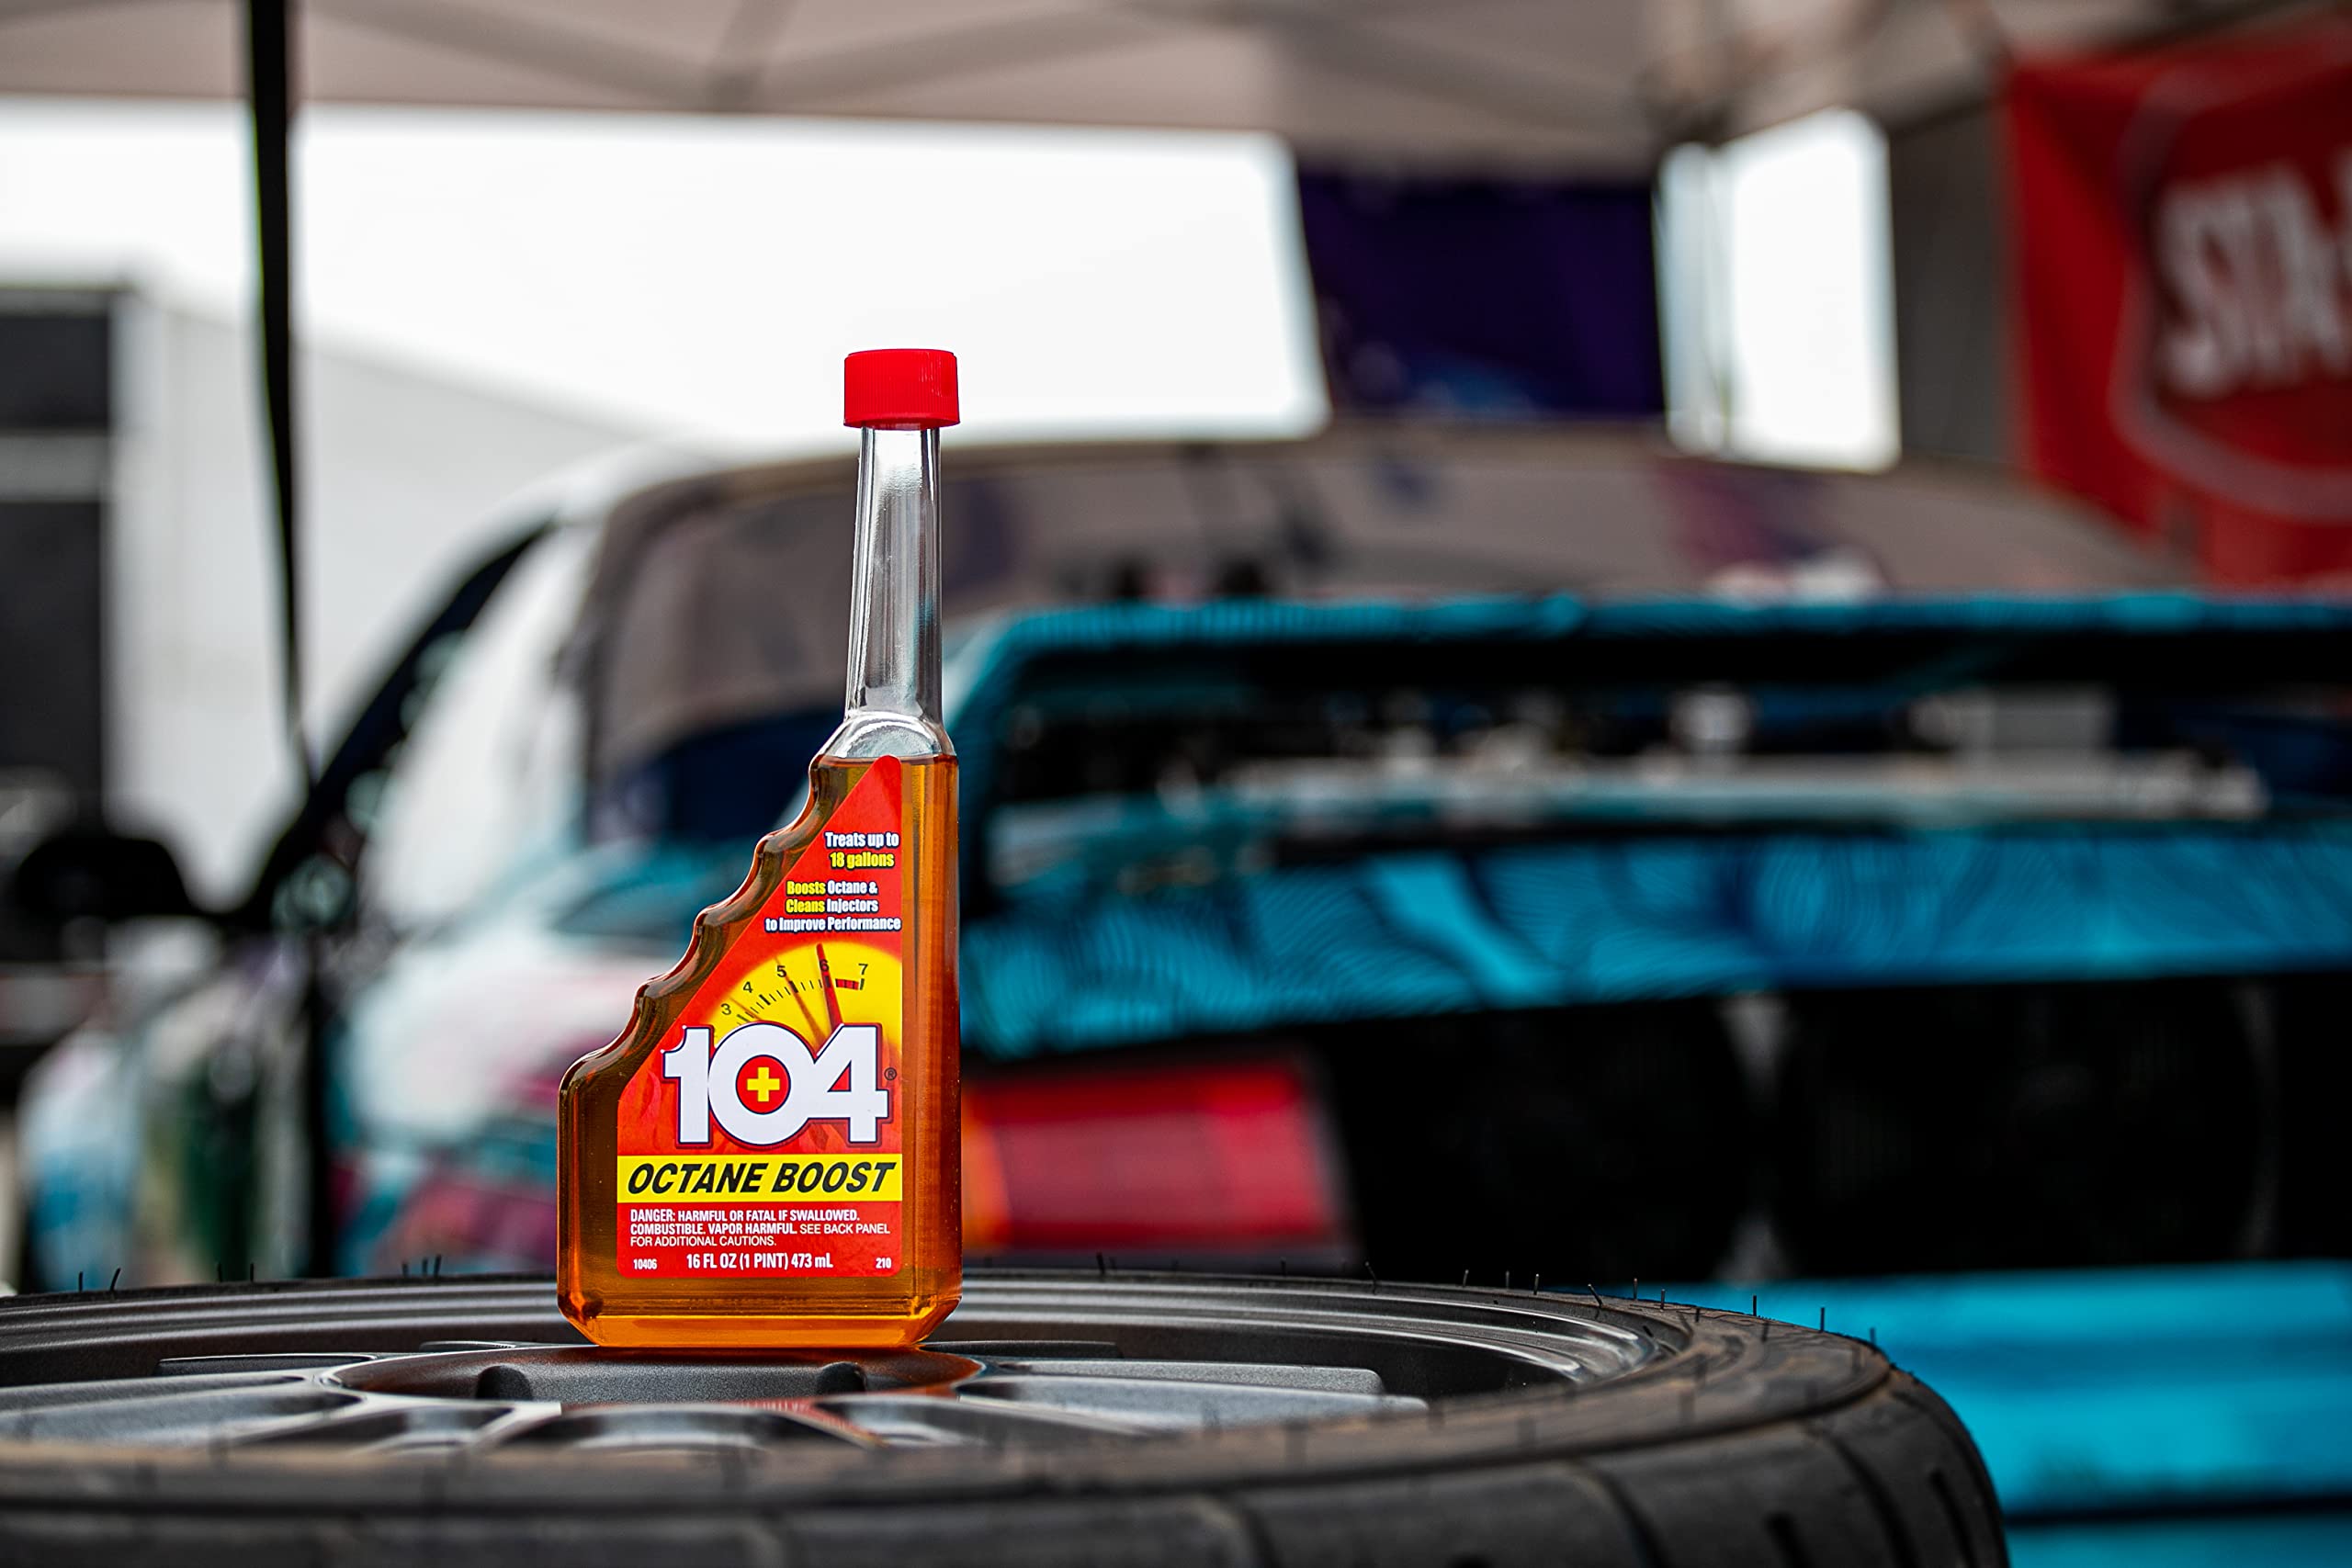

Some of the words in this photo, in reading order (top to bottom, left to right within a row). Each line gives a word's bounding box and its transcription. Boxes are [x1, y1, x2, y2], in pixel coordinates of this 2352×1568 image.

[825, 831, 865, 848] Treats
[867, 832, 884, 849] up
[886, 832, 899, 847] to
[830, 852, 844, 868] 18
[846, 852, 895, 870] gallons
[786, 880, 826, 895] Boosts
[827, 880, 867, 894] Octane
[868, 881, 878, 894] &
[786, 898, 825, 913] Cleans
[827, 898, 879, 914] Injectors
[764, 918, 778, 931] to
[779, 917, 826, 932] Improve
[827, 916, 901, 931] Performance
[720, 1002, 732, 1016] 3
[742, 981, 753, 994] 4
[776, 964, 787, 978] 5
[819, 958, 830, 973] 6
[858, 963, 868, 976] 7
[628, 1162, 769, 1194] OCTANE
[772, 1161, 898, 1193] BOOST
[630, 1209, 676, 1223] DANGER:
[678, 1210, 728, 1222] HARMFUL
[729, 1210, 745, 1222] OR
[746, 1210, 776, 1222] FATAL
[778, 1210, 788, 1222] IF
[789, 1209, 860, 1222] SWALLOWED.
[630, 1223, 707, 1235] COMBUSTIBLE.
[707, 1223, 743, 1235] VAPOR
[799, 1223, 821, 1235] SEE
[823, 1223, 854, 1235] BACK
[855, 1223, 890, 1235] PANEL
[630, 1235, 653, 1247] FOR
[654, 1235, 718, 1247] ADDITIONAL
[719, 1235, 777, 1247] CAUTIONS.
[633, 1258, 658, 1269] 10406
[686, 1253, 701, 1269] 16
[703, 1253, 718, 1269] FL
[719, 1253, 737, 1269] OZ
[739, 1252, 750, 1270] (1
[753, 1252, 789, 1270] PINT)
[791, 1253, 812, 1269] 473
[814, 1252, 833, 1268] mL
[876, 1257, 892, 1269] 210
